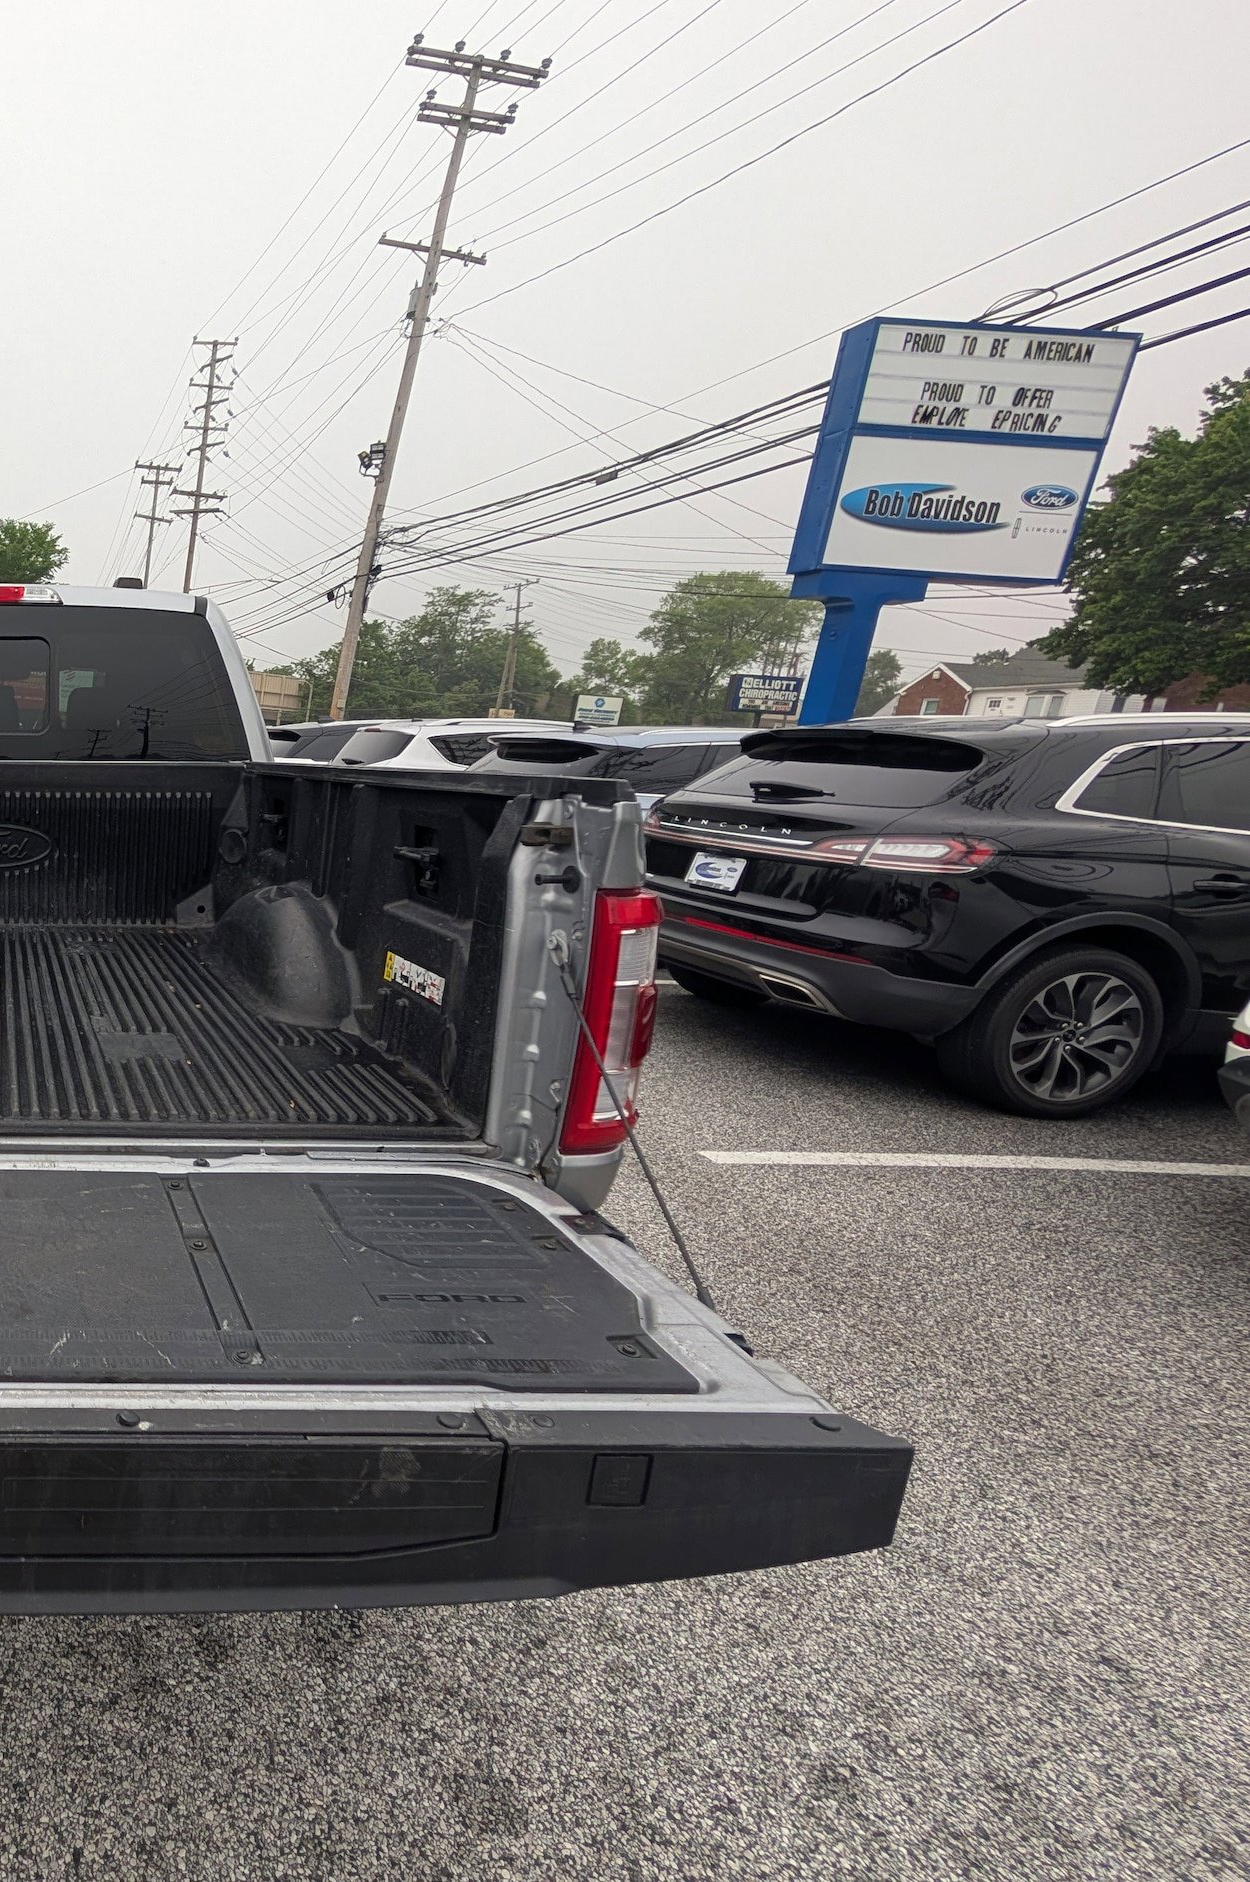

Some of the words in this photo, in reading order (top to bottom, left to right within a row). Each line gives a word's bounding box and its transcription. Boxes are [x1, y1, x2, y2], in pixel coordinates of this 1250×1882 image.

[902, 332, 946, 353] PROUD
[961, 335, 978, 356] TO
[989, 338, 1010, 358] BE
[1023, 340, 1095, 363] AMERICAN
[920, 381, 964, 403] PROUD
[978, 384, 996, 405] TO
[1012, 387, 1054, 409] OFFER
[864, 489, 904, 518] Bob
[906, 491, 1001, 524] Davidson
[1030, 487, 1069, 507] Ford
[739, 688, 798, 701] CHIROPRACTIC
[753, 678, 797, 691] ELLIOTT
[674, 815, 792, 835] LINCOLN
[377, 1293, 528, 1304] FORD
